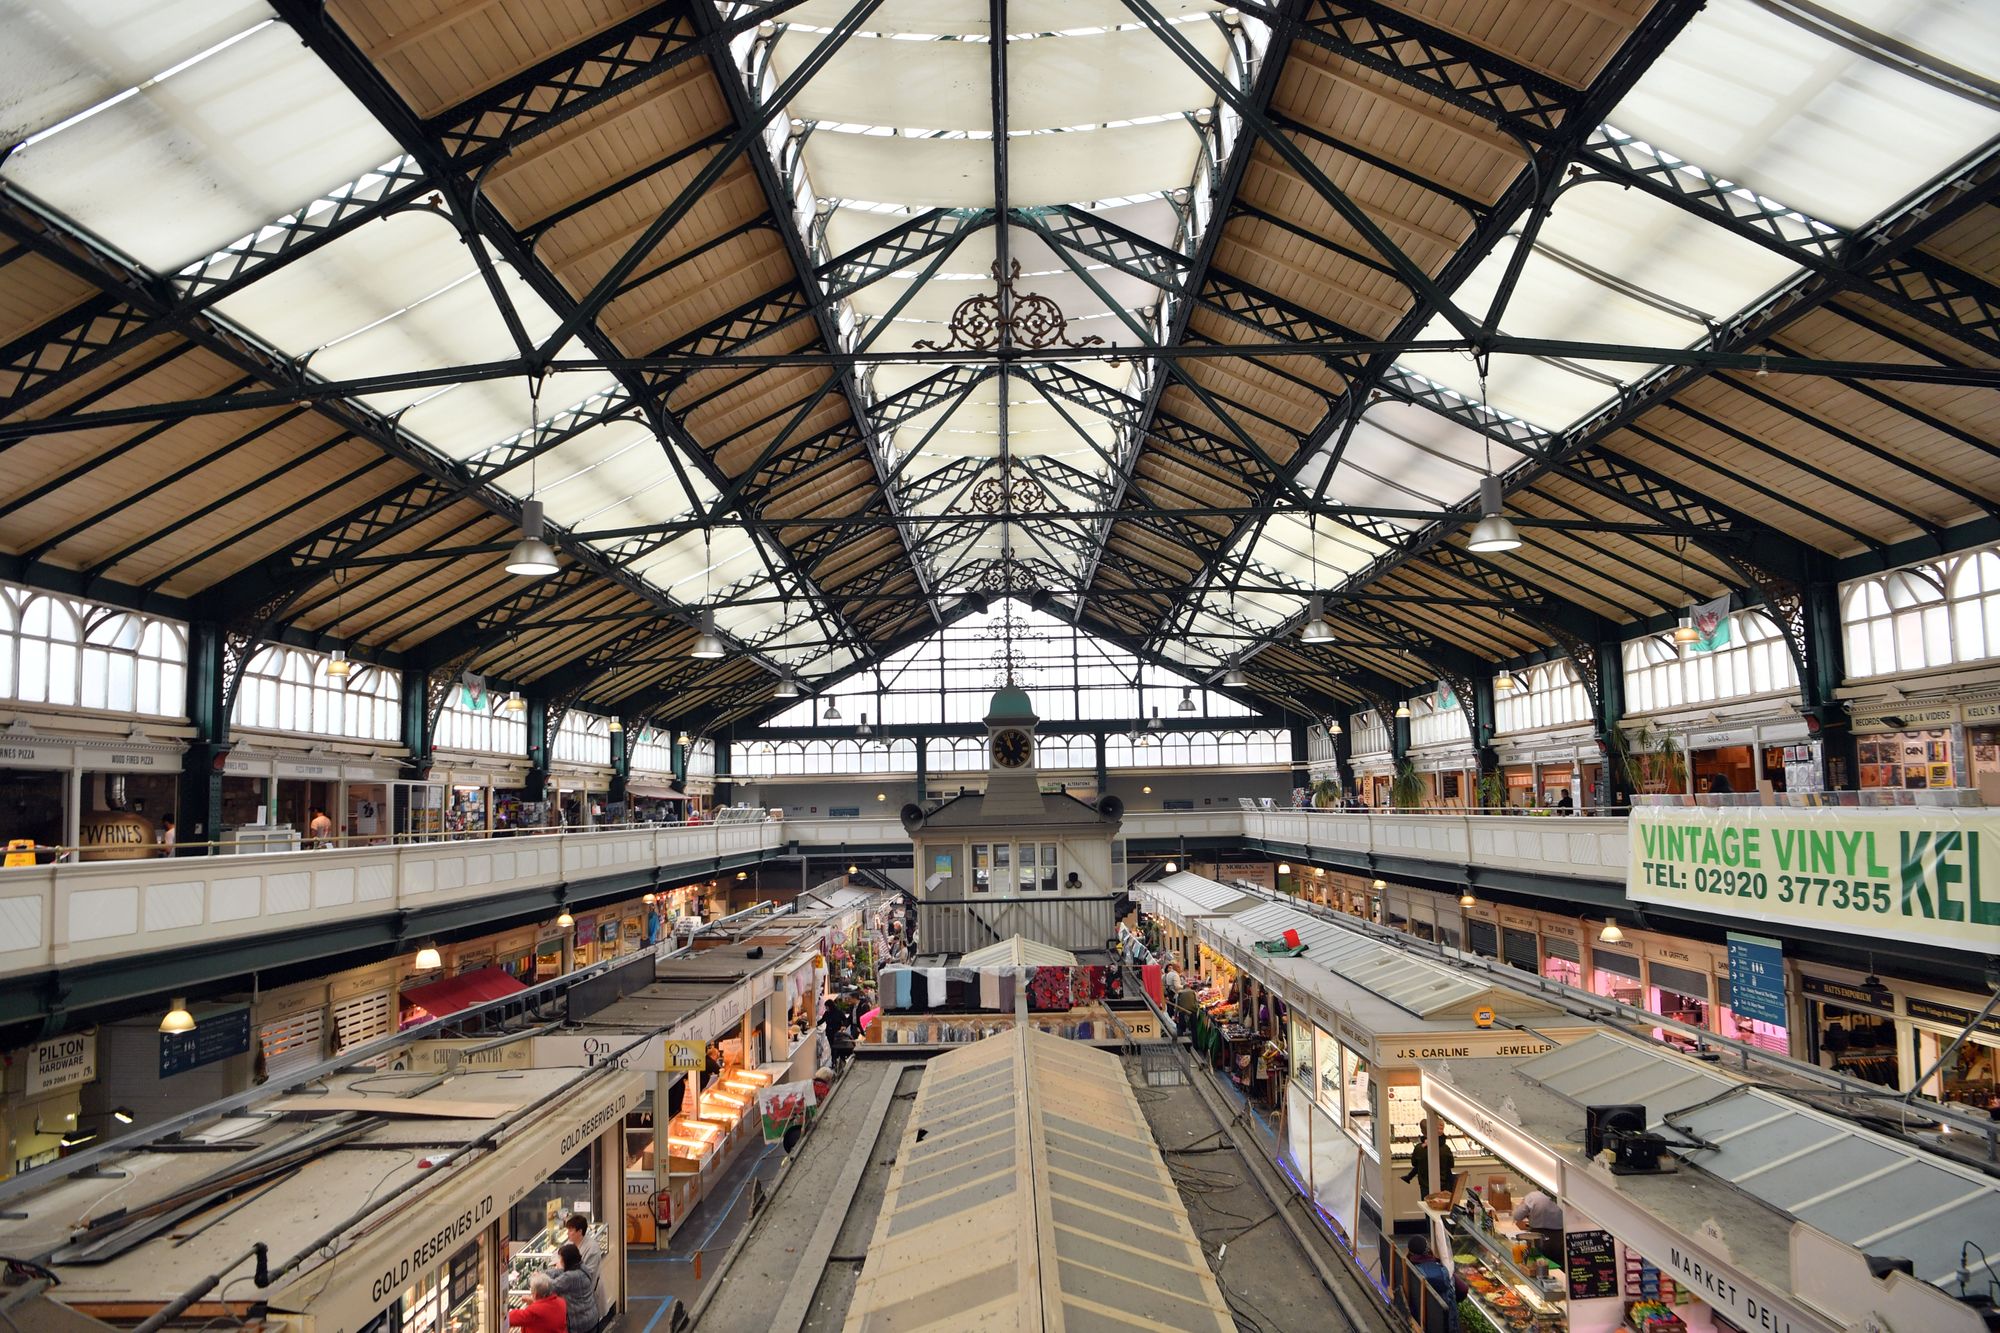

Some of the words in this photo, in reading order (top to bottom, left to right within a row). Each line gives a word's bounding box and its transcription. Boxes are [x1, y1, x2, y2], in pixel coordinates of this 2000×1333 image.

[1925, 711, 1950, 721] VIDEOS
[1968, 705, 1995, 717] KELLY'S
[18, 750, 34, 759] PIZZA
[126, 755, 139, 764] FIRED
[140, 755, 153, 764] PIZZA
[1640, 824, 1761, 869] VINTAGE
[1771, 829, 1889, 878] VINYL
[1642, 862, 1687, 890] TEL:
[1694, 867, 1768, 900] 02920
[1778, 875, 1891, 914] 377355
[39, 1038, 84, 1061] PILTON
[583, 1037, 610, 1055] On
[669, 1043, 688, 1056] On
[1421, 1048, 1469, 1057] CARLINE
[39, 1056, 84, 1075] HARDWARE
[671, 1055, 702, 1067] Time
[561, 1129, 580, 1155] GOLD
[582, 1102, 614, 1140] RESERVES
[615, 1094, 626, 1113] LTD
[372, 1259, 408, 1303] GOLD
[413, 1211, 472, 1274] RESERVES
[475, 1195, 493, 1224] LTD
[1671, 1248, 1737, 1306] MARKET
